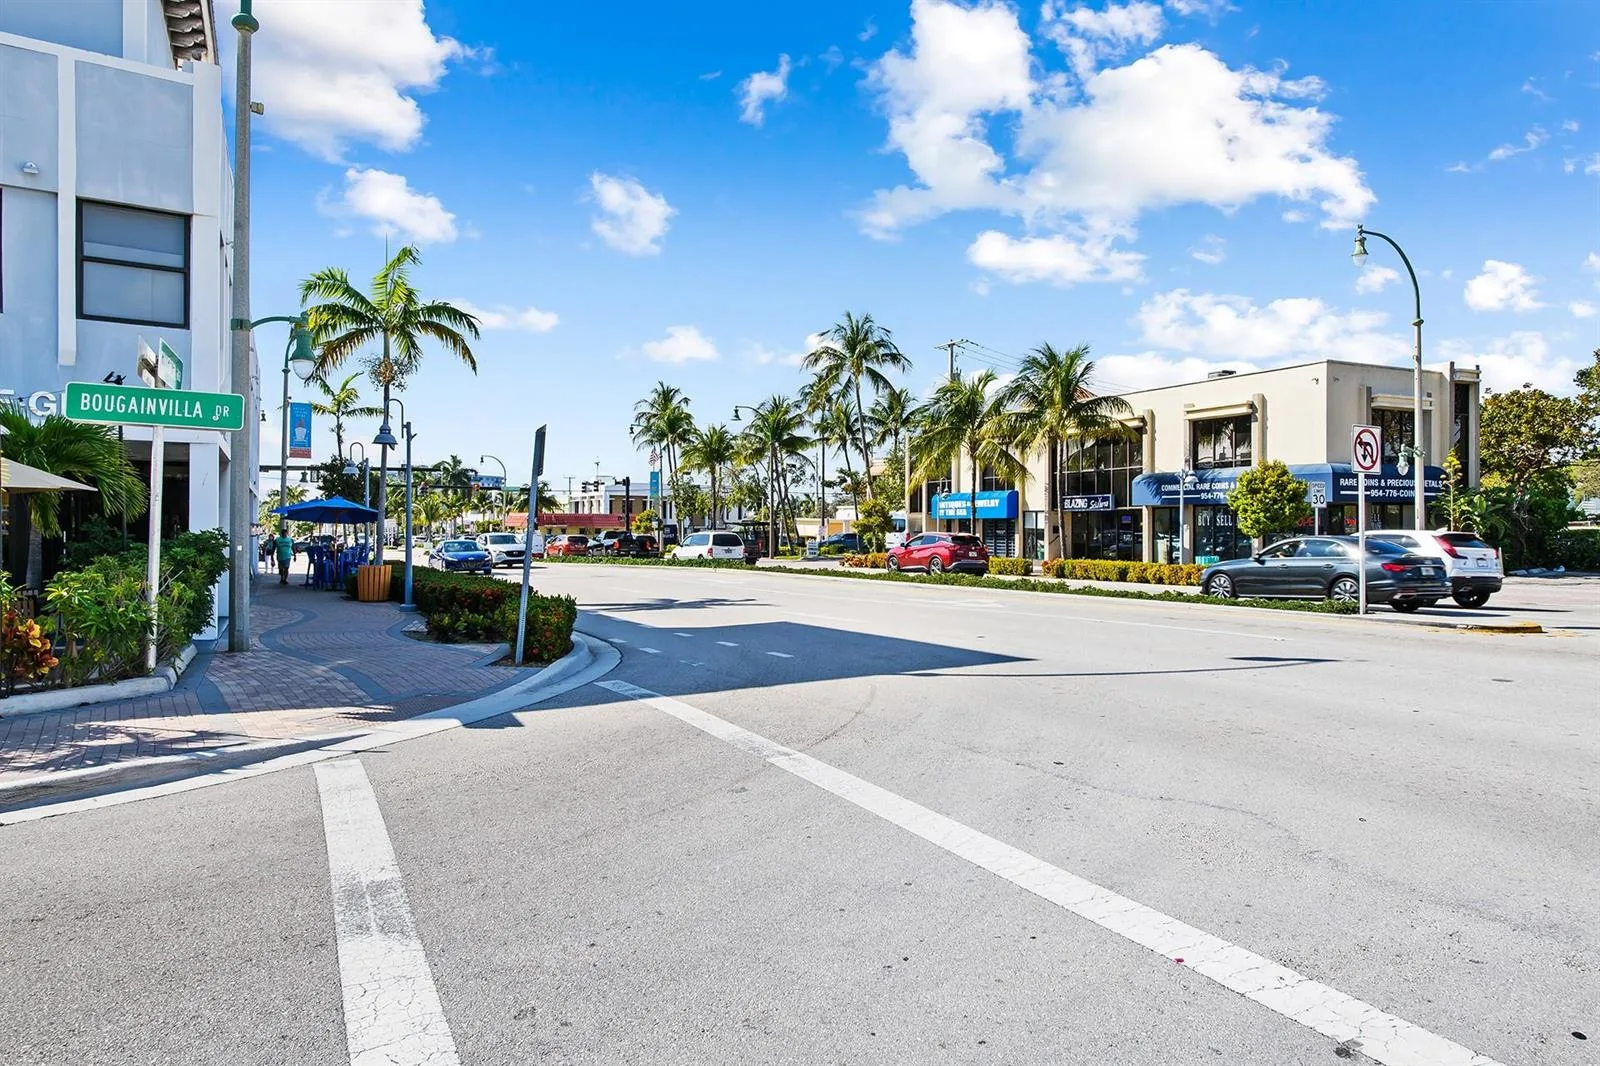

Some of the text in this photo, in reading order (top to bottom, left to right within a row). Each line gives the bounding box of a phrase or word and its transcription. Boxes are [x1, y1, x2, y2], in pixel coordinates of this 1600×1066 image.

[80, 393, 230, 419] BOUGAINVILLA DR
[1161, 483, 1195, 492] COMMECIAL
[1340, 478, 1358, 486] RARE
[1363, 479, 1379, 487] OINS
[1424, 480, 1443, 488] ETALS
[1370, 489, 1415, 497] 954-776-COIN
[974, 499, 1000, 508] EWELRY
[1064, 498, 1088, 509] BLAZING
[1312, 494, 1326, 505] 30
[1197, 515, 1210, 526] BUY
[1216, 515, 1233, 526] SELL
